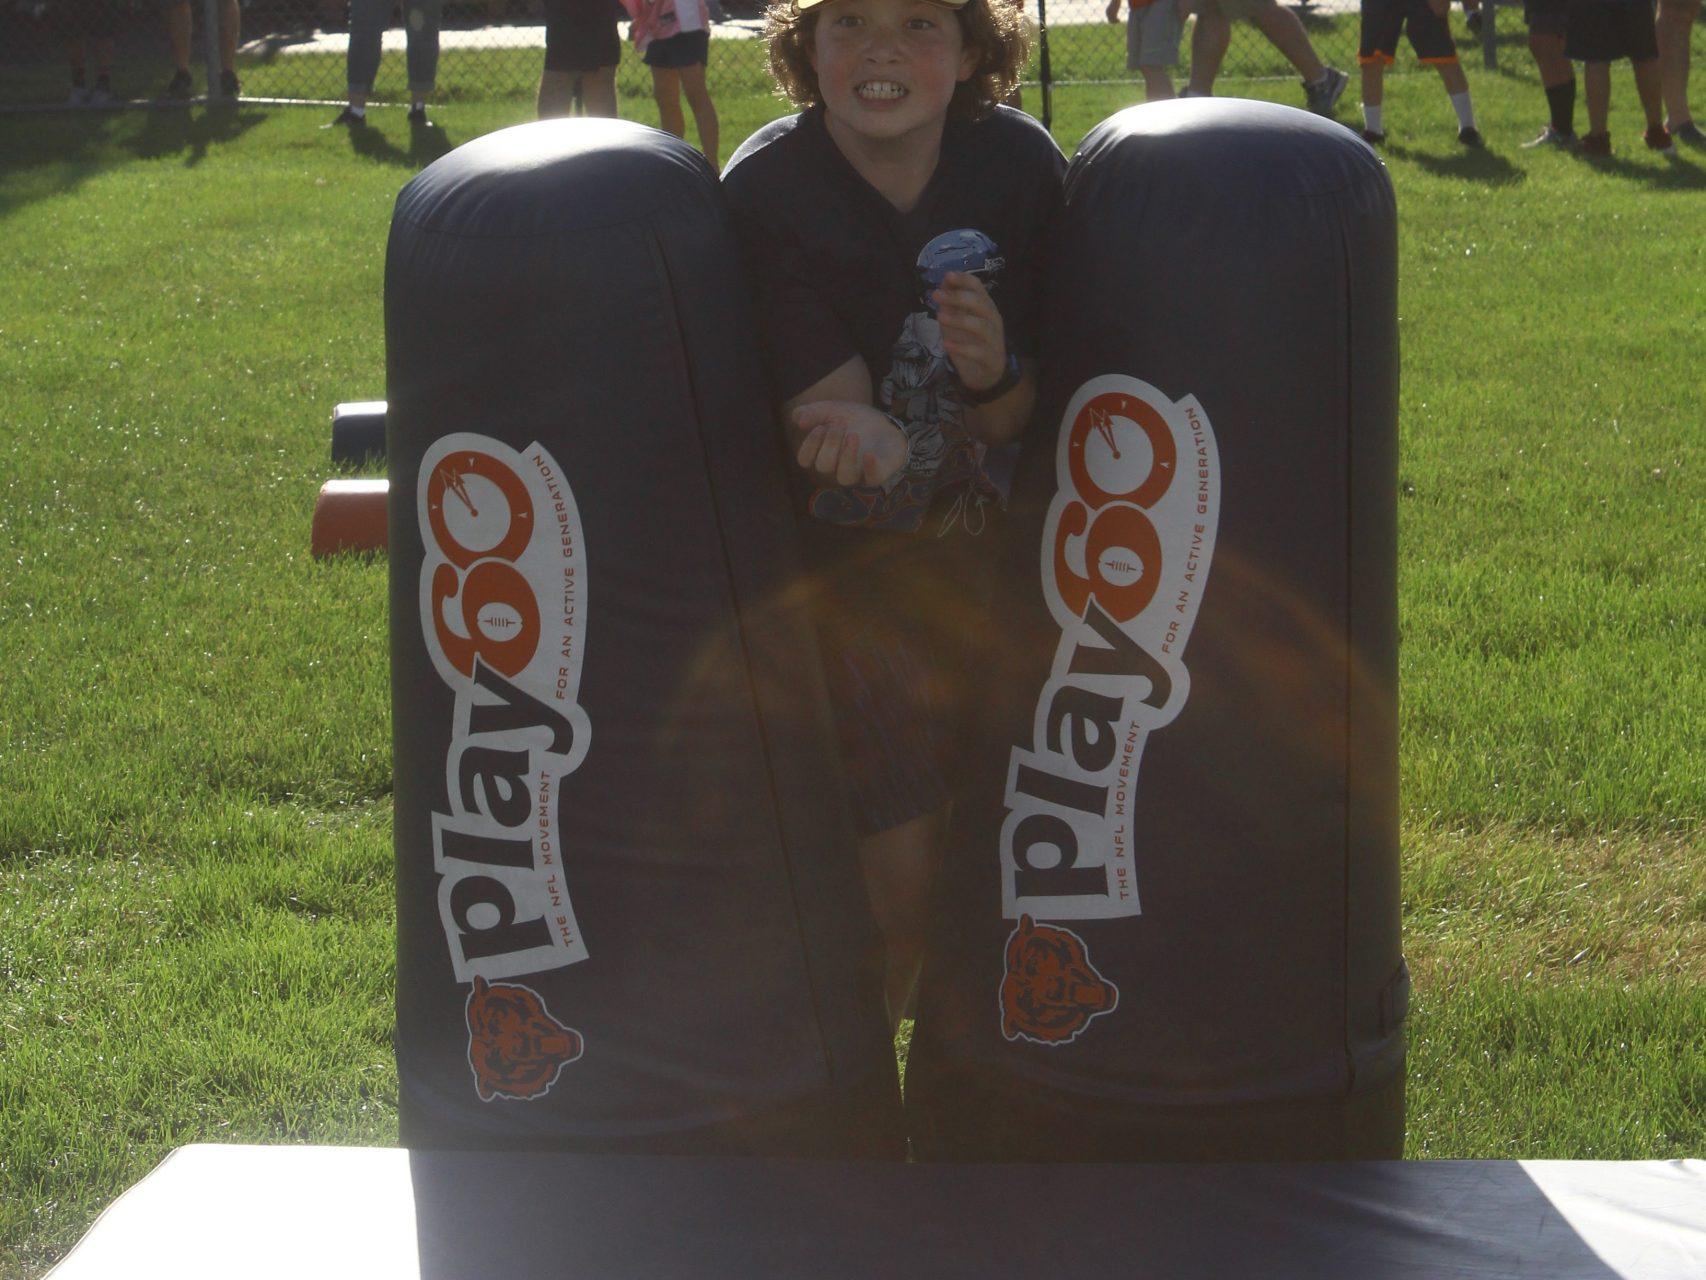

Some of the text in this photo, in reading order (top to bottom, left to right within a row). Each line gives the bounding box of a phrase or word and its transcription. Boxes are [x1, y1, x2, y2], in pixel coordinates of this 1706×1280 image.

[532, 454, 575, 700] FOR AN ACTIVE GENERATION
[1012, 391, 1178, 900] play 60
[1161, 407, 1208, 653] FOR AN ACTIVE GENERATION
[426, 450, 575, 963] play 60
[1114, 720, 1141, 901] THE NFL MOVEMENT
[538, 770, 572, 948] THE NFL MOVEMENT
